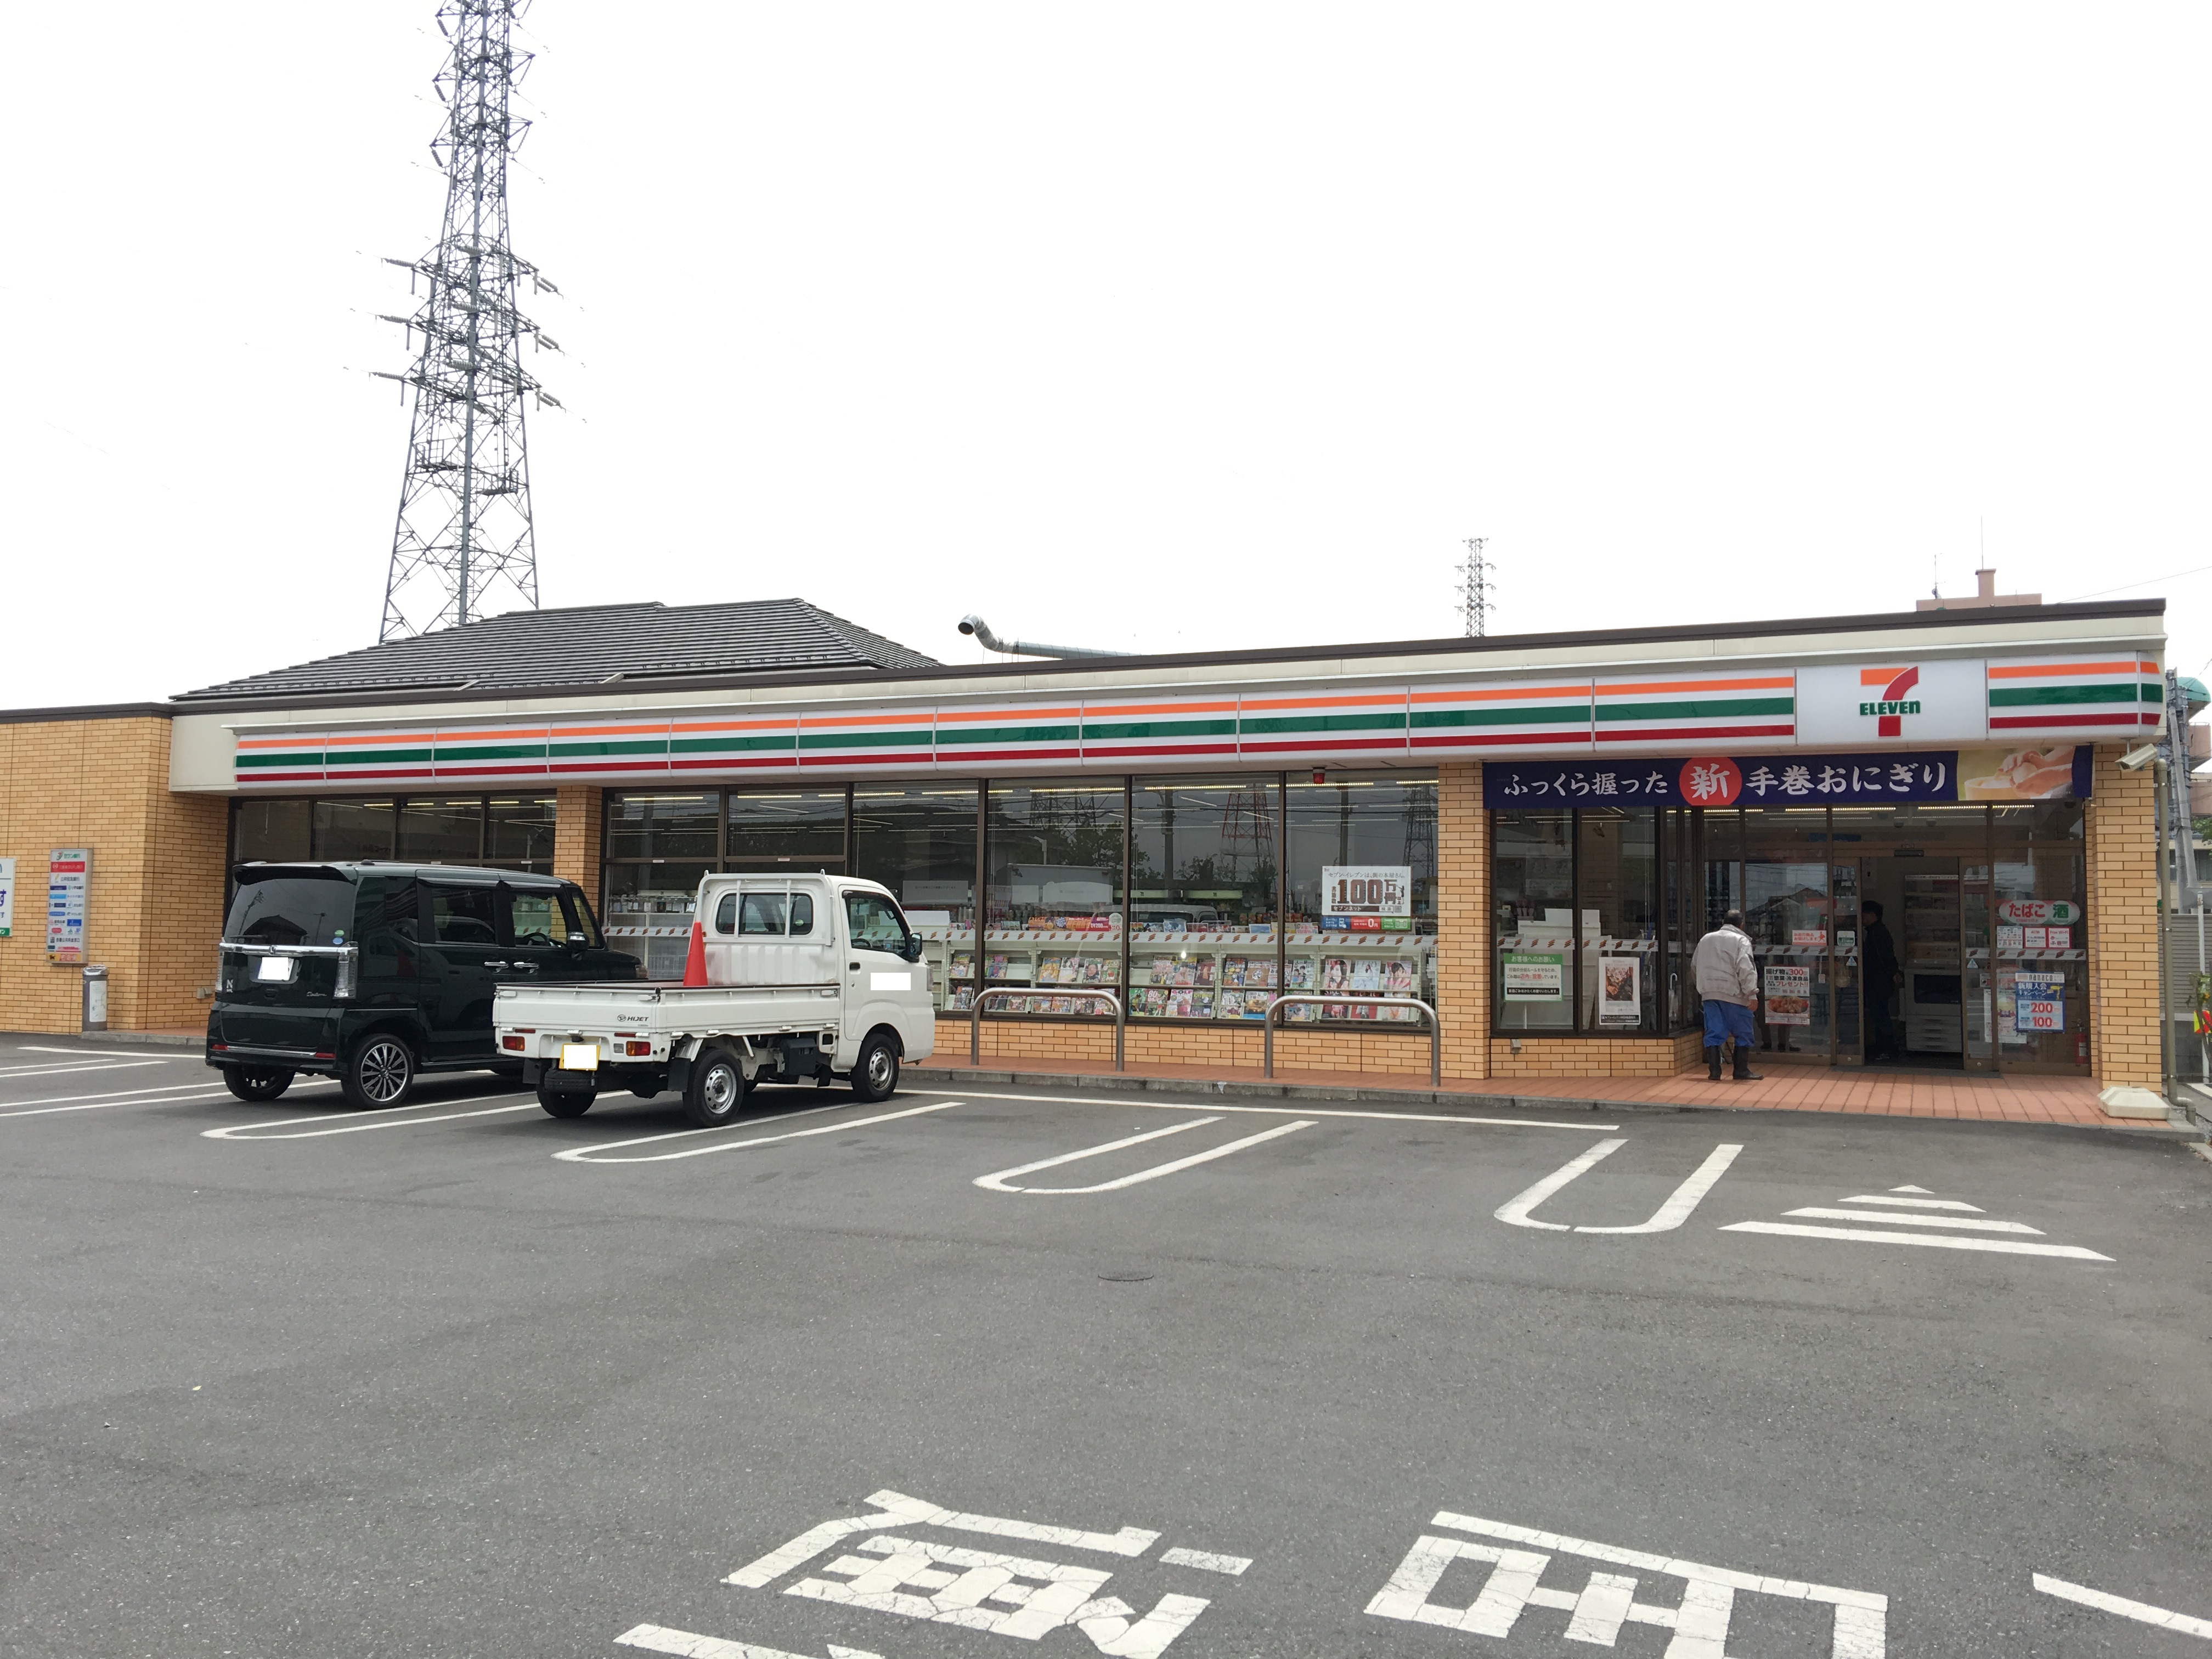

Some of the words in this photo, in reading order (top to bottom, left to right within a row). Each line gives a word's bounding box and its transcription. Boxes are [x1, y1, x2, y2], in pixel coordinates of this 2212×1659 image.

[1504, 770, 1667, 797] ふっくら握った
[1690, 764, 1730, 800] 新
[1746, 763, 1946, 797] 手巻おにぎり
[2009, 903, 2046, 918] たばこ
[2053, 904, 2069, 918] 酒
[2031, 1002, 2053, 1013] 200
[2032, 1017, 2052, 1028] 100
